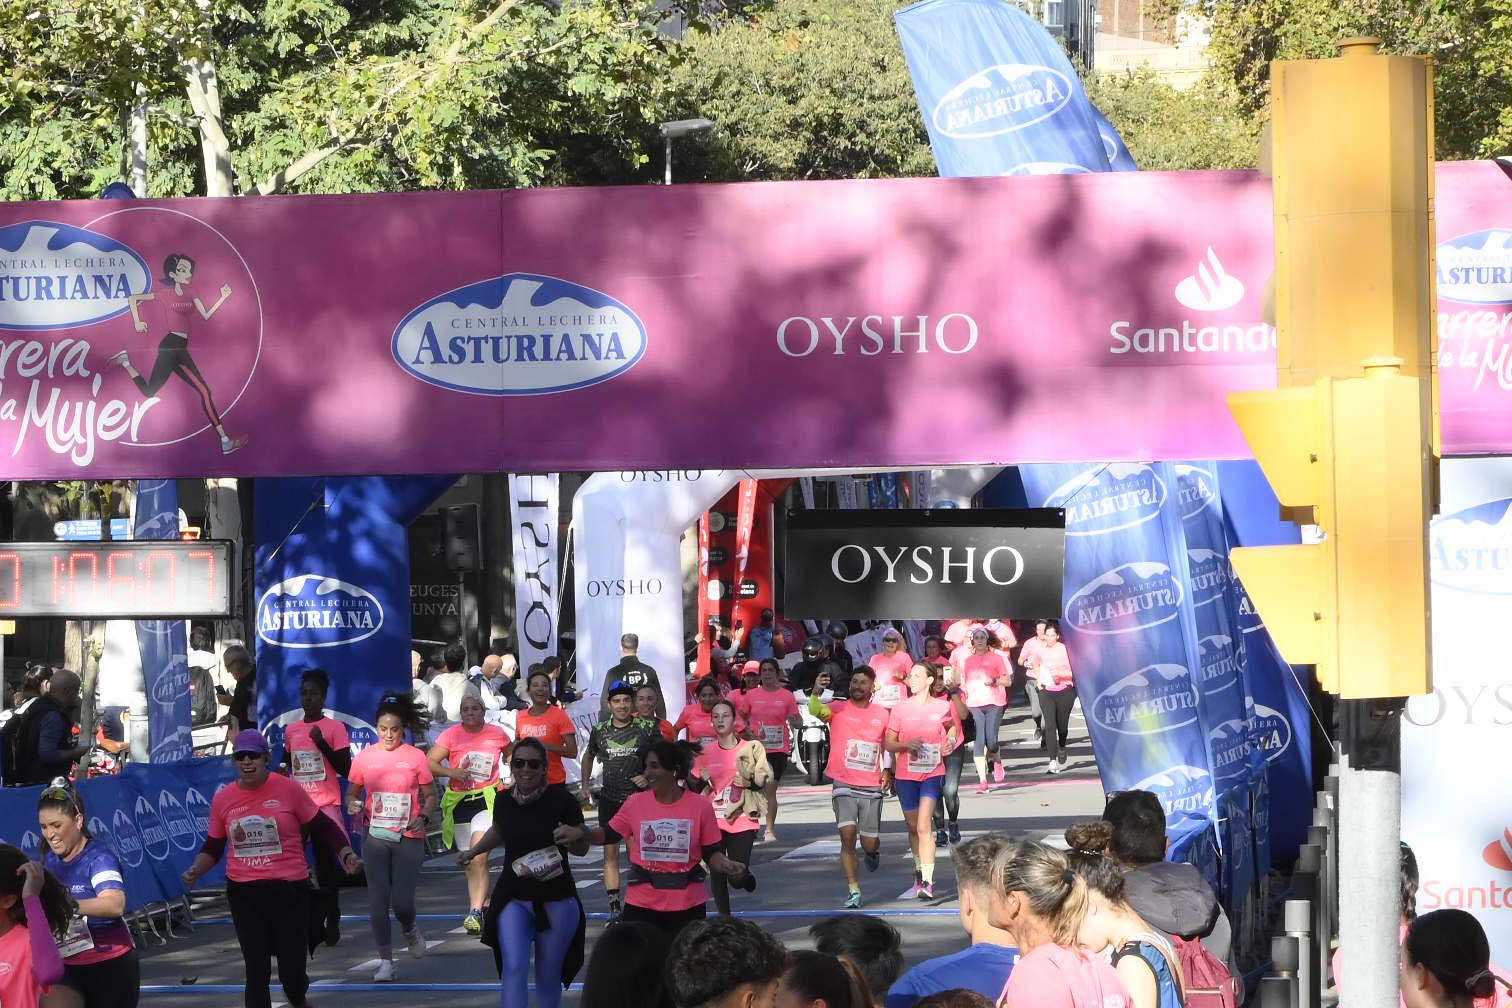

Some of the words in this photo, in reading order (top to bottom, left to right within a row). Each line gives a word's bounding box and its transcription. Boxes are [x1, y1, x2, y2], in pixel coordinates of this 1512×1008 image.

[54, 255, 127, 269] LECHERA
[451, 315, 529, 330] CENTRAL
[538, 313, 619, 327] LECHERA
[777, 313, 979, 357] OYSHO
[1109, 320, 1278, 354] Santand
[411, 321, 627, 365] ASTURIANA
[12, 373, 160, 466] Mujer
[831, 543, 1025, 585] OYSHO
[320, 599, 370, 608] LECHERA
[587, 578, 662, 598] OYSHO
[261, 603, 375, 632] ASTURIANA
